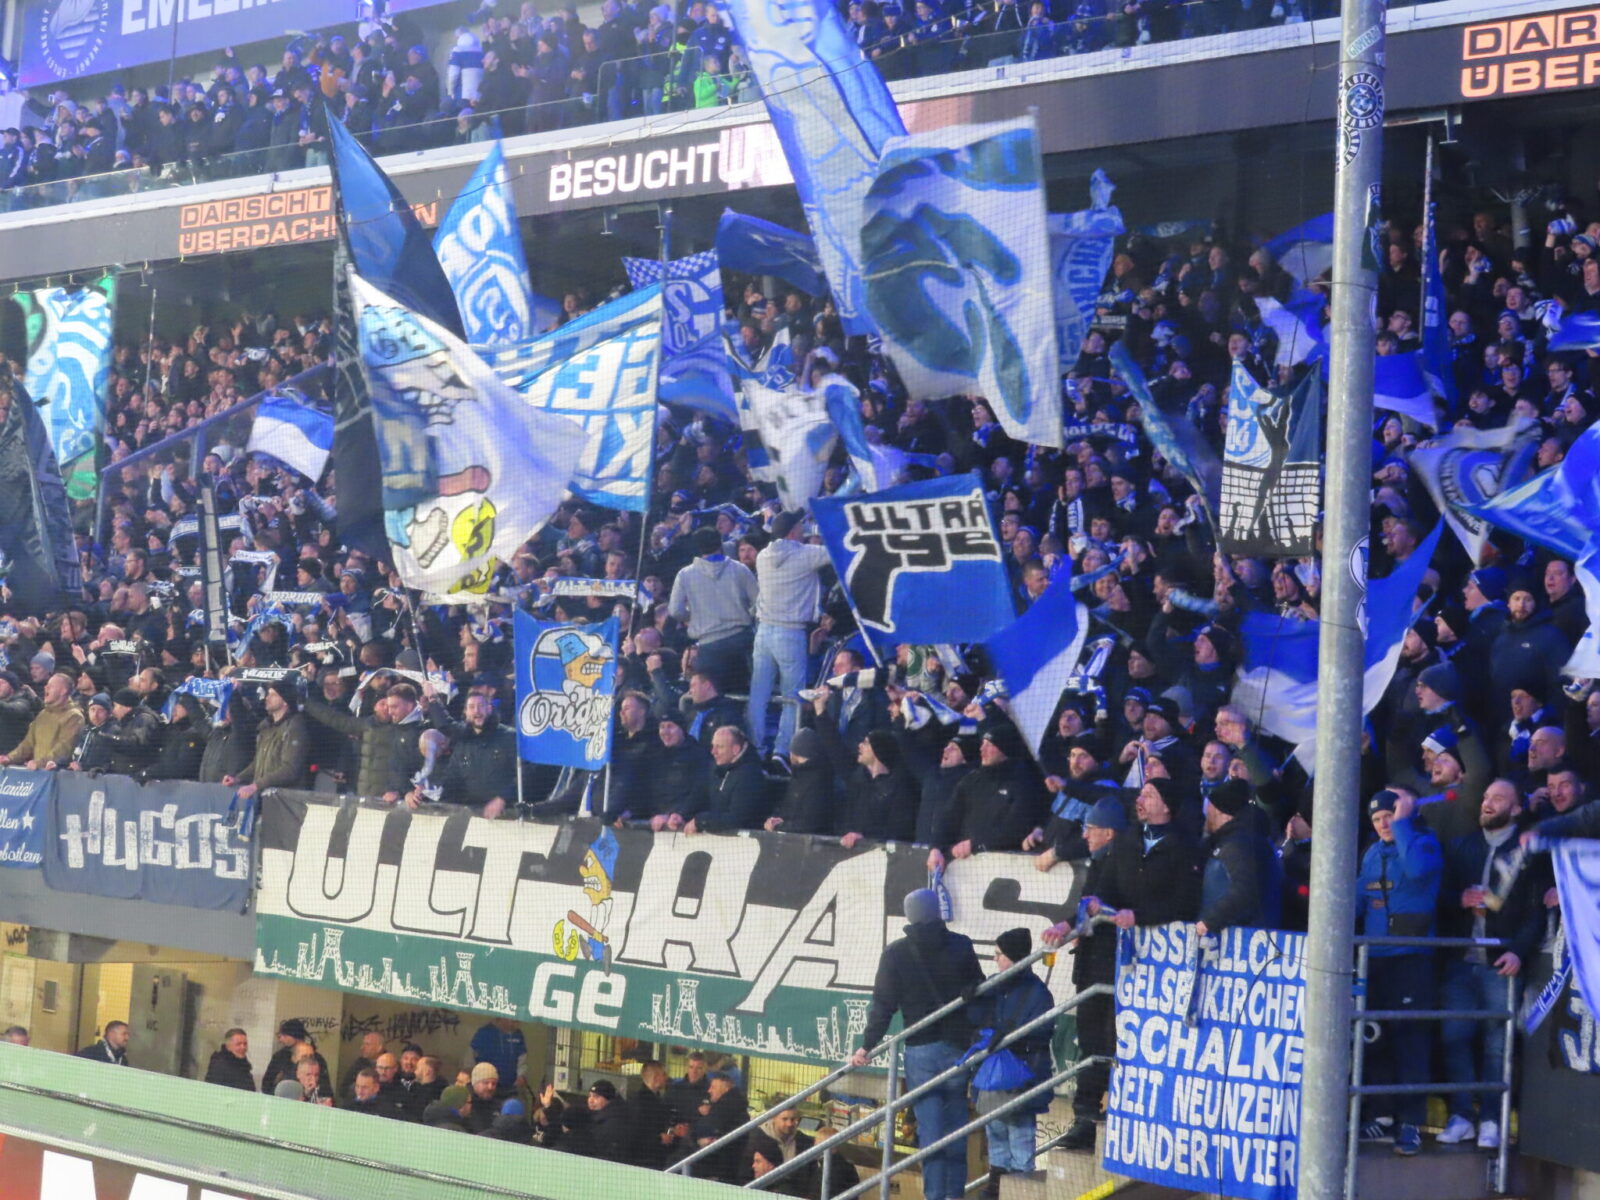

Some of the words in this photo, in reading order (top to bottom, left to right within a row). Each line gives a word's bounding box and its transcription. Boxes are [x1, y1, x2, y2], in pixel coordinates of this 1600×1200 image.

[549, 141, 720, 201] BESUCHT
[183, 188, 330, 227] DARSCHT
[60, 791, 249, 880] HUGOS
[1116, 1010, 1304, 1084] SCHALKE
[1110, 1065, 1164, 1118] SEIT
[1172, 1075, 1299, 1137] NEUNZEHN
